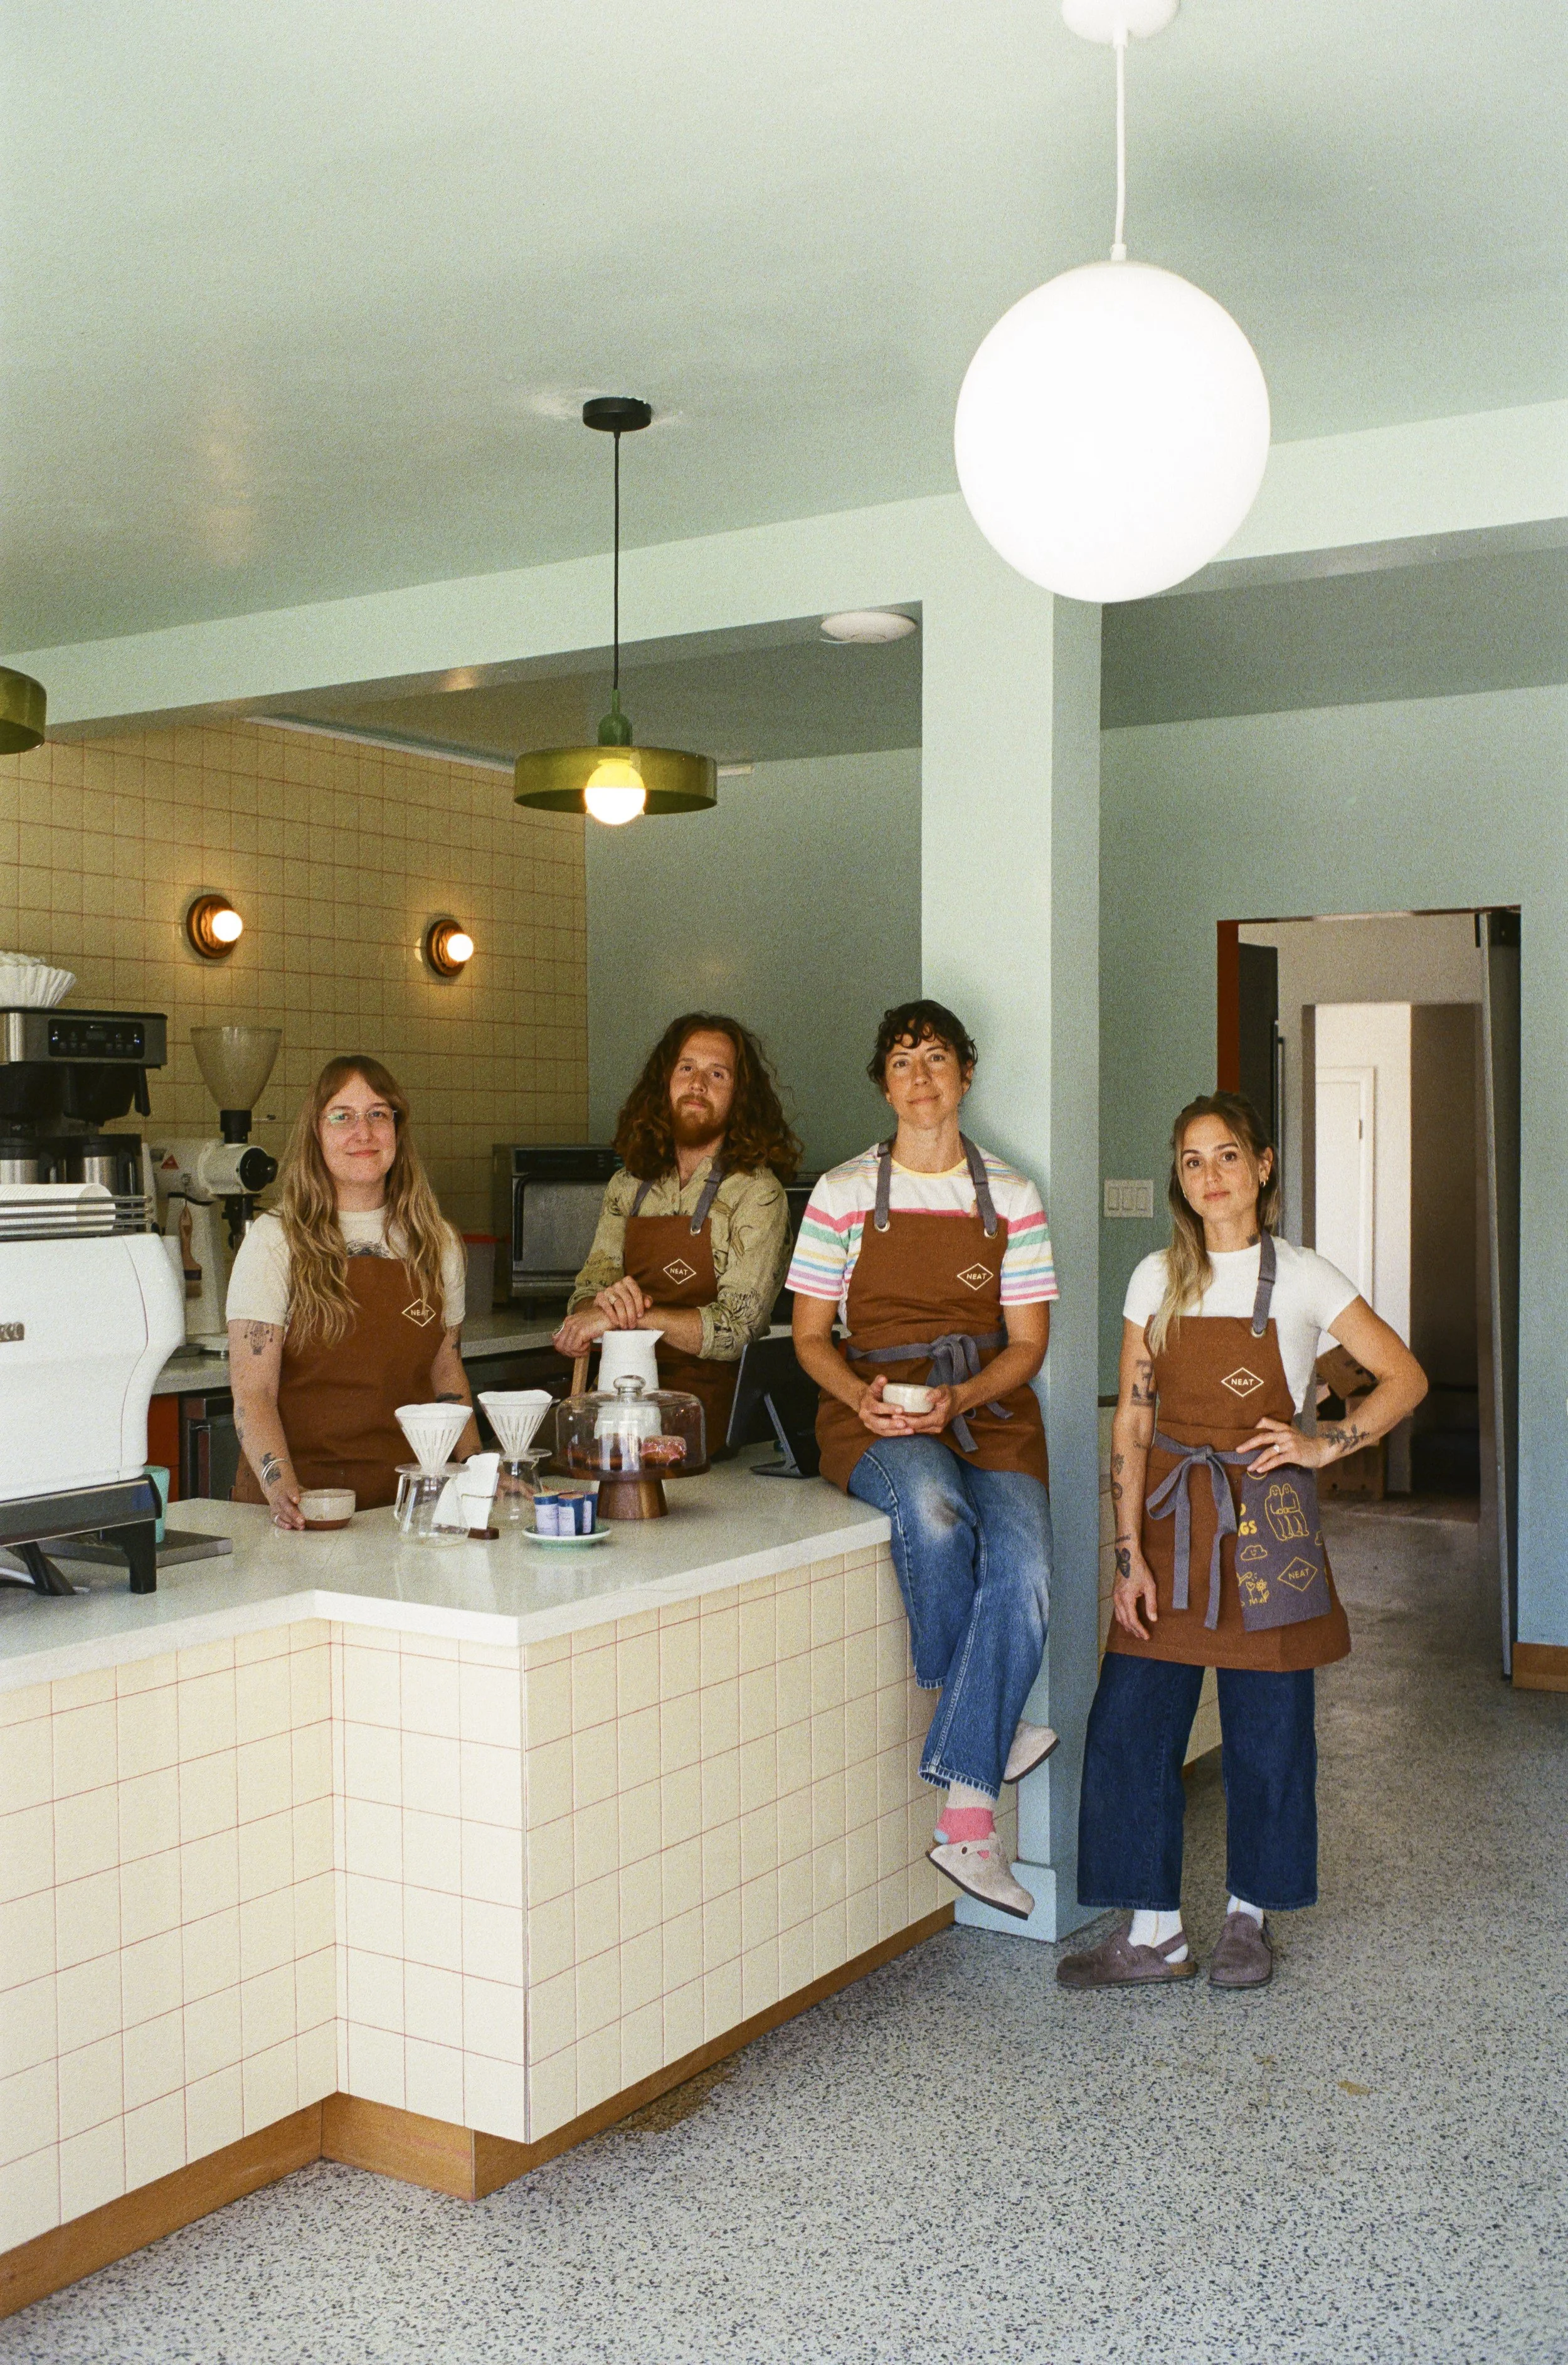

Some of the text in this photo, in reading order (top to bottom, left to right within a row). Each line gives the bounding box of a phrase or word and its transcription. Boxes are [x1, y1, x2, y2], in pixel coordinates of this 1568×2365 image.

[670, 1268, 688, 1276] NEAT
[1238, 1520, 1257, 1537] GS
[1288, 1568, 1310, 1580] NEAT
